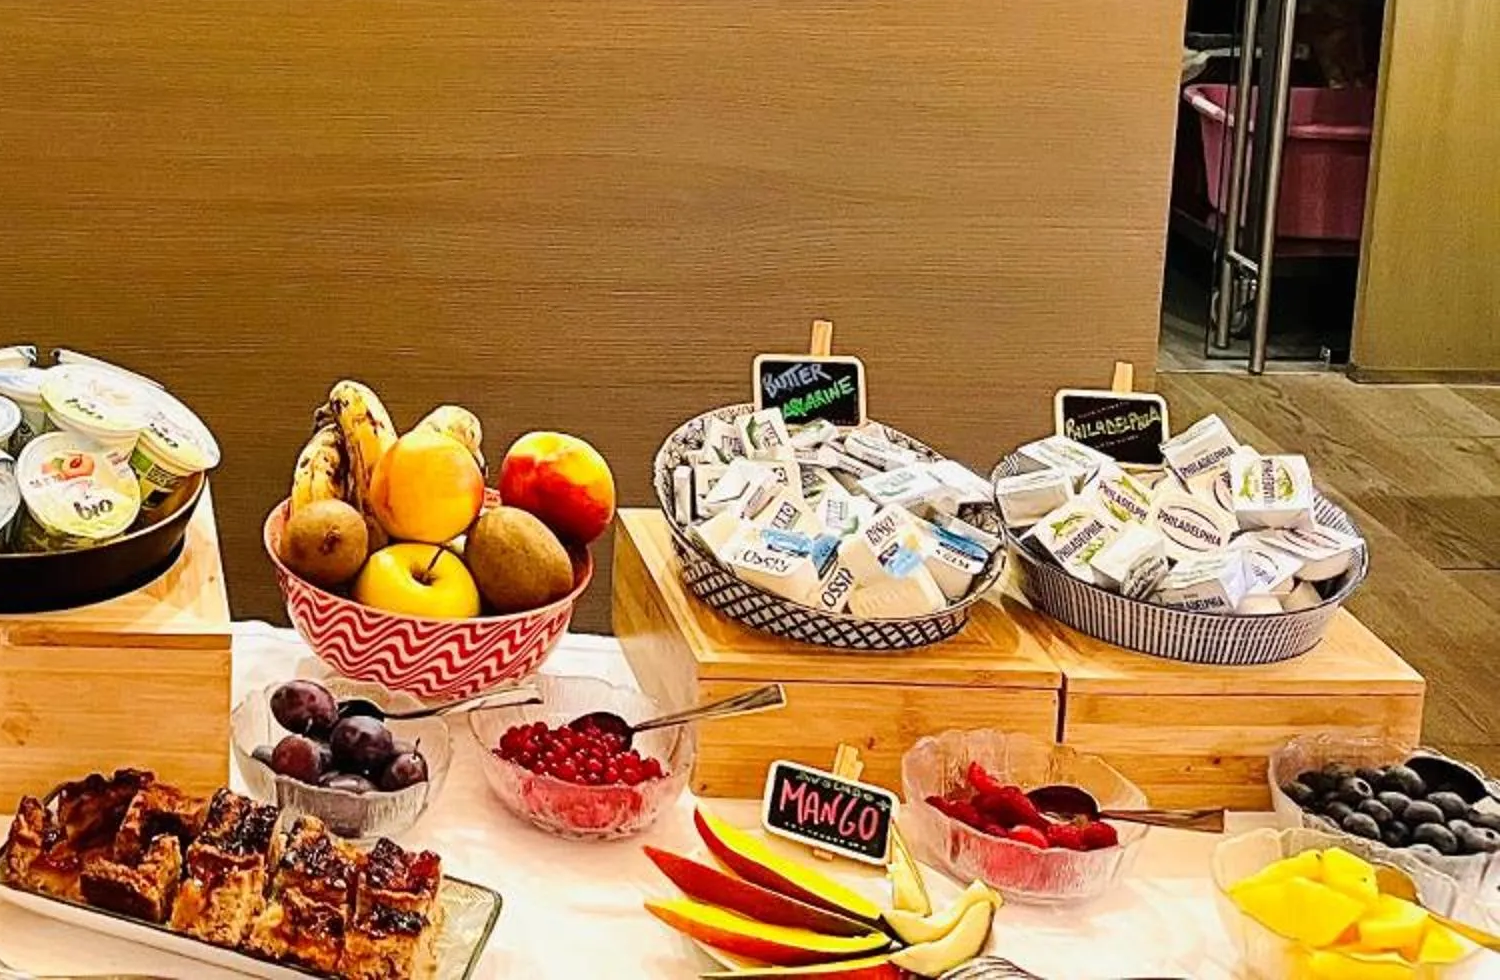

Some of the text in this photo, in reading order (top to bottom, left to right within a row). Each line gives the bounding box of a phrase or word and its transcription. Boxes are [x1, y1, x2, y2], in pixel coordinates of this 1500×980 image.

[762, 363, 833, 399] BUTTER
[783, 375, 856, 420] ARGARINE
[1065, 406, 1161, 440] PHILADELPHIA
[1179, 445, 1236, 478] PHILADELPHIA
[1099, 481, 1148, 520] PHILADELPH
[1055, 519, 1105, 563] PHILADELPHIA
[1157, 508, 1222, 547] PHILADELPHIA
[778, 777, 879, 841] MANGO
